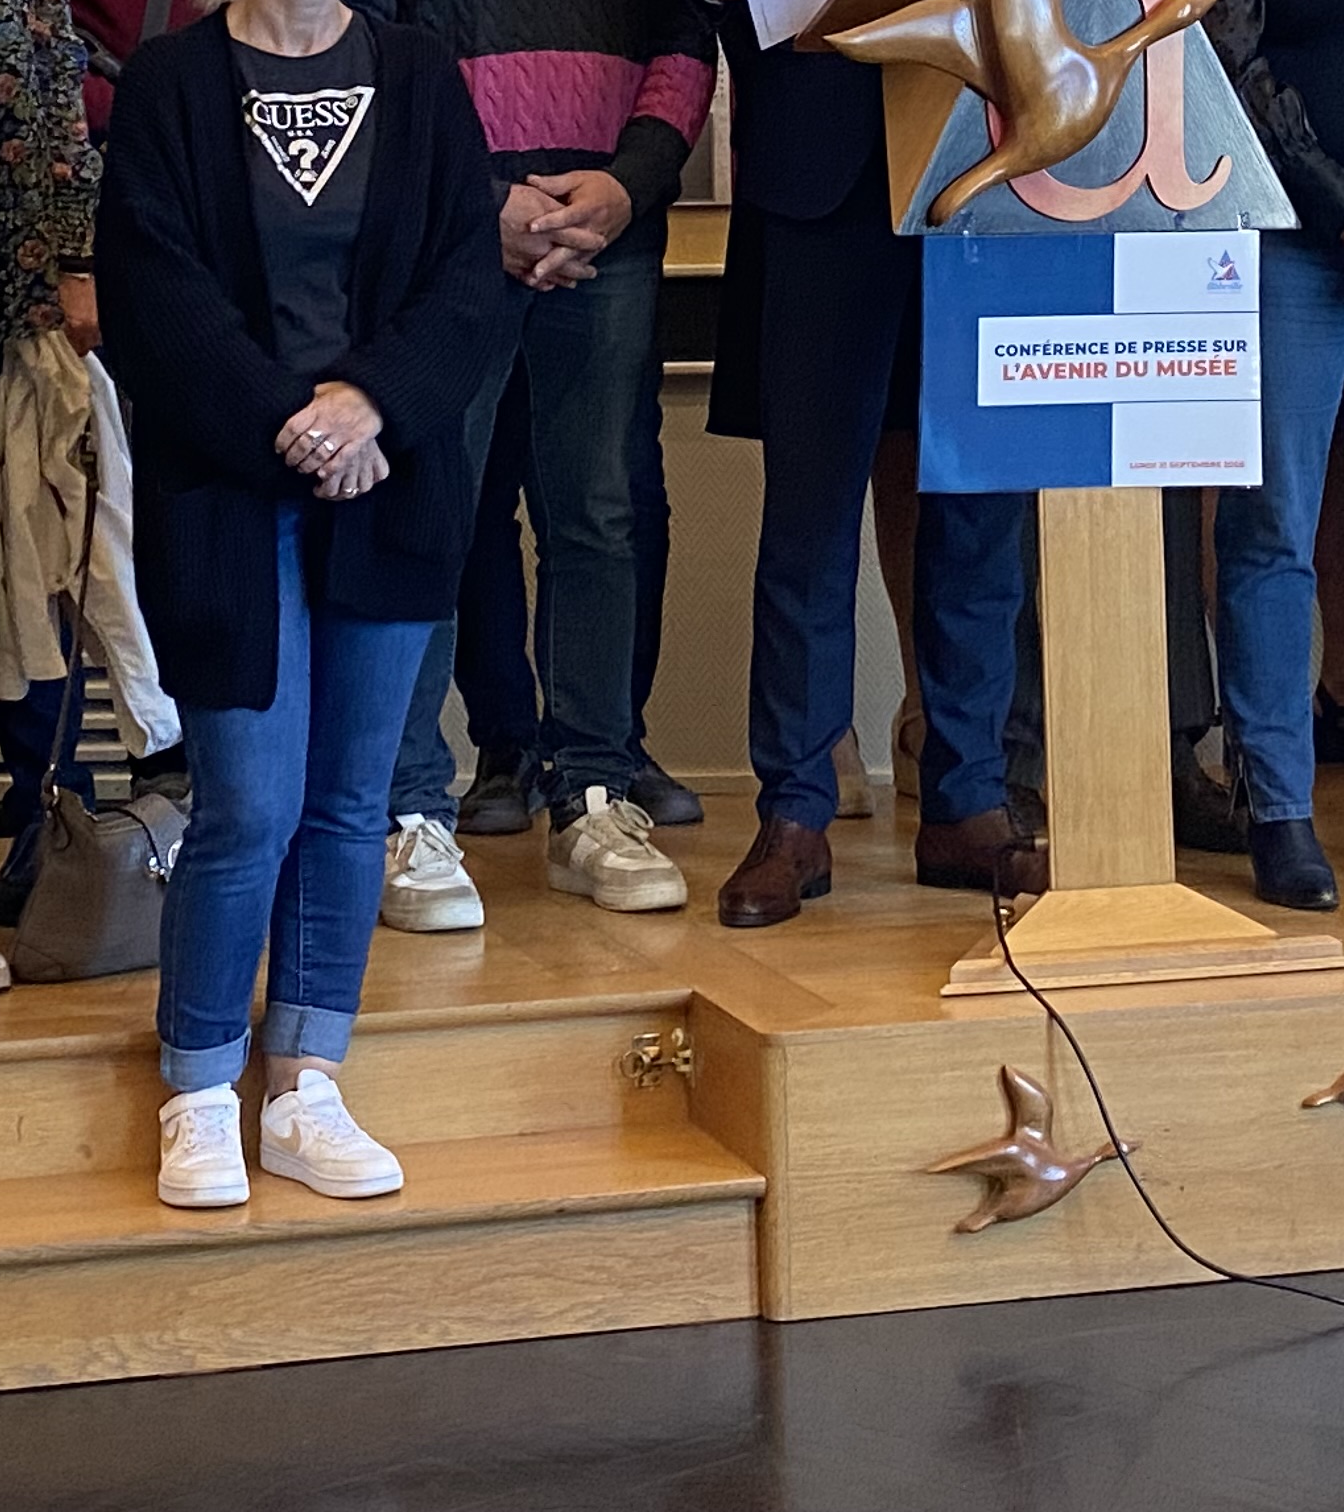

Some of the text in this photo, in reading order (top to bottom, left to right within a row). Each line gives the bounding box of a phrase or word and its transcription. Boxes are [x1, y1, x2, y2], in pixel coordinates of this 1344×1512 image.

[252, 101, 350, 130] GUESS
[994, 339, 1248, 357] CONFÉRENCE DE PRESSE SUR
[1002, 354, 1237, 381] L'AVENIR DU MUSÉE
